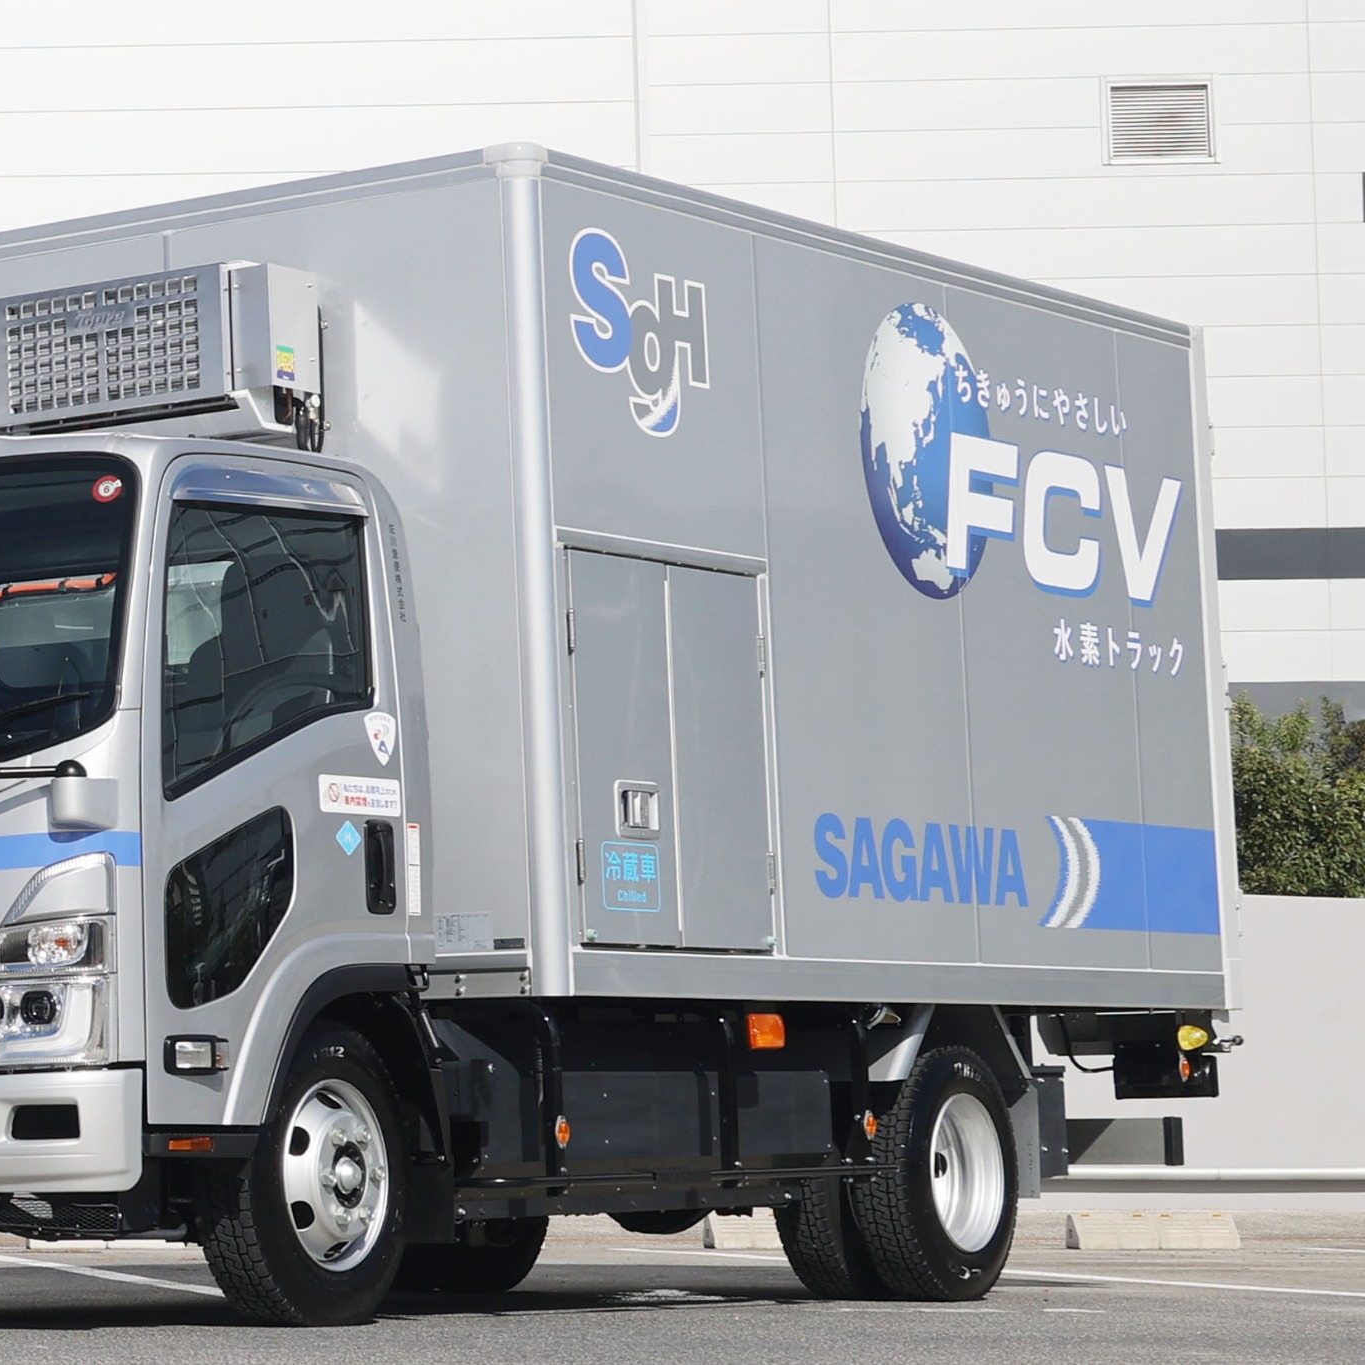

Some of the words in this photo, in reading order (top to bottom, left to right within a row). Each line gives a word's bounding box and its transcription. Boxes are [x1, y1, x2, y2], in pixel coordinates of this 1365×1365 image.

[954, 364, 1128, 436] ちきゅうにやさしい
[946, 432, 1183, 609] FCV
[1052, 618, 1185, 677] 水素トラック
[604, 851, 657, 883] 冷蔵車
[813, 812, 1030, 907] SAGAWA
[617, 889, 647, 903] Chilled
